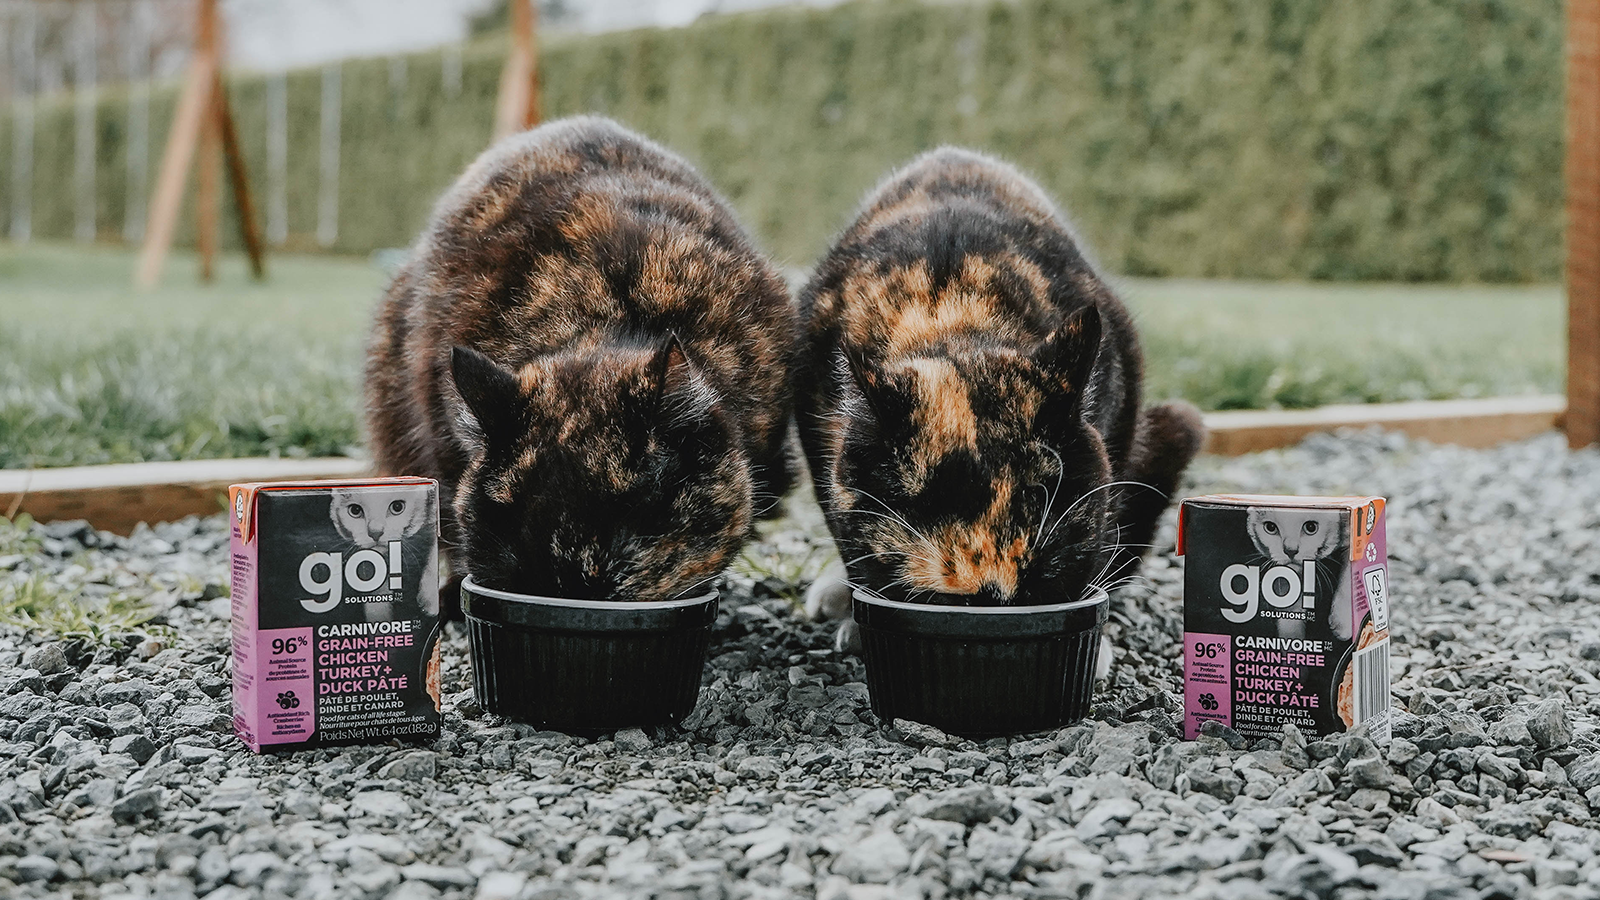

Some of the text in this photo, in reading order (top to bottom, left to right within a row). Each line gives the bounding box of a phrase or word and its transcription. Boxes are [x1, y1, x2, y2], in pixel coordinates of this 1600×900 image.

[298, 540, 402, 613] go!
[345, 594, 393, 604] SOLUTIONS
[1220, 560, 1315, 623] go!
[1260, 610, 1306, 620] SOLUTIONS
[318, 621, 411, 637] CARNIVORE
[272, 636, 308, 655] 96%
[318, 635, 414, 651] GRAIN-FREE
[1195, 642, 1226, 658] 96%
[1235, 636, 1322, 652] CARNIVORE
[318, 650, 388, 666] CHICKEN
[1235, 650, 1325, 666] GRAIN-FREE
[319, 665, 381, 680] TURKEY
[1235, 663, 1300, 679] CHICKEN
[320, 674, 408, 694] DUCK PÂTÉ
[1235, 676, 1293, 692] TURKEY
[320, 695, 343, 705] PÂTÉ
[360, 693, 399, 702] POULET,
[1236, 690, 1319, 708] DUCK PÂTÉ
[320, 705, 349, 714] DINDE
[364, 701, 404, 710] CANARD
[1236, 704, 1257, 713] PÂTÉ
[1273, 708, 1310, 718] POULET,
[320, 722, 354, 730] Nourriture
[1236, 713, 1263, 722] DINDE
[1277, 717, 1316, 726] CANARD
[320, 731, 347, 741] Poids
